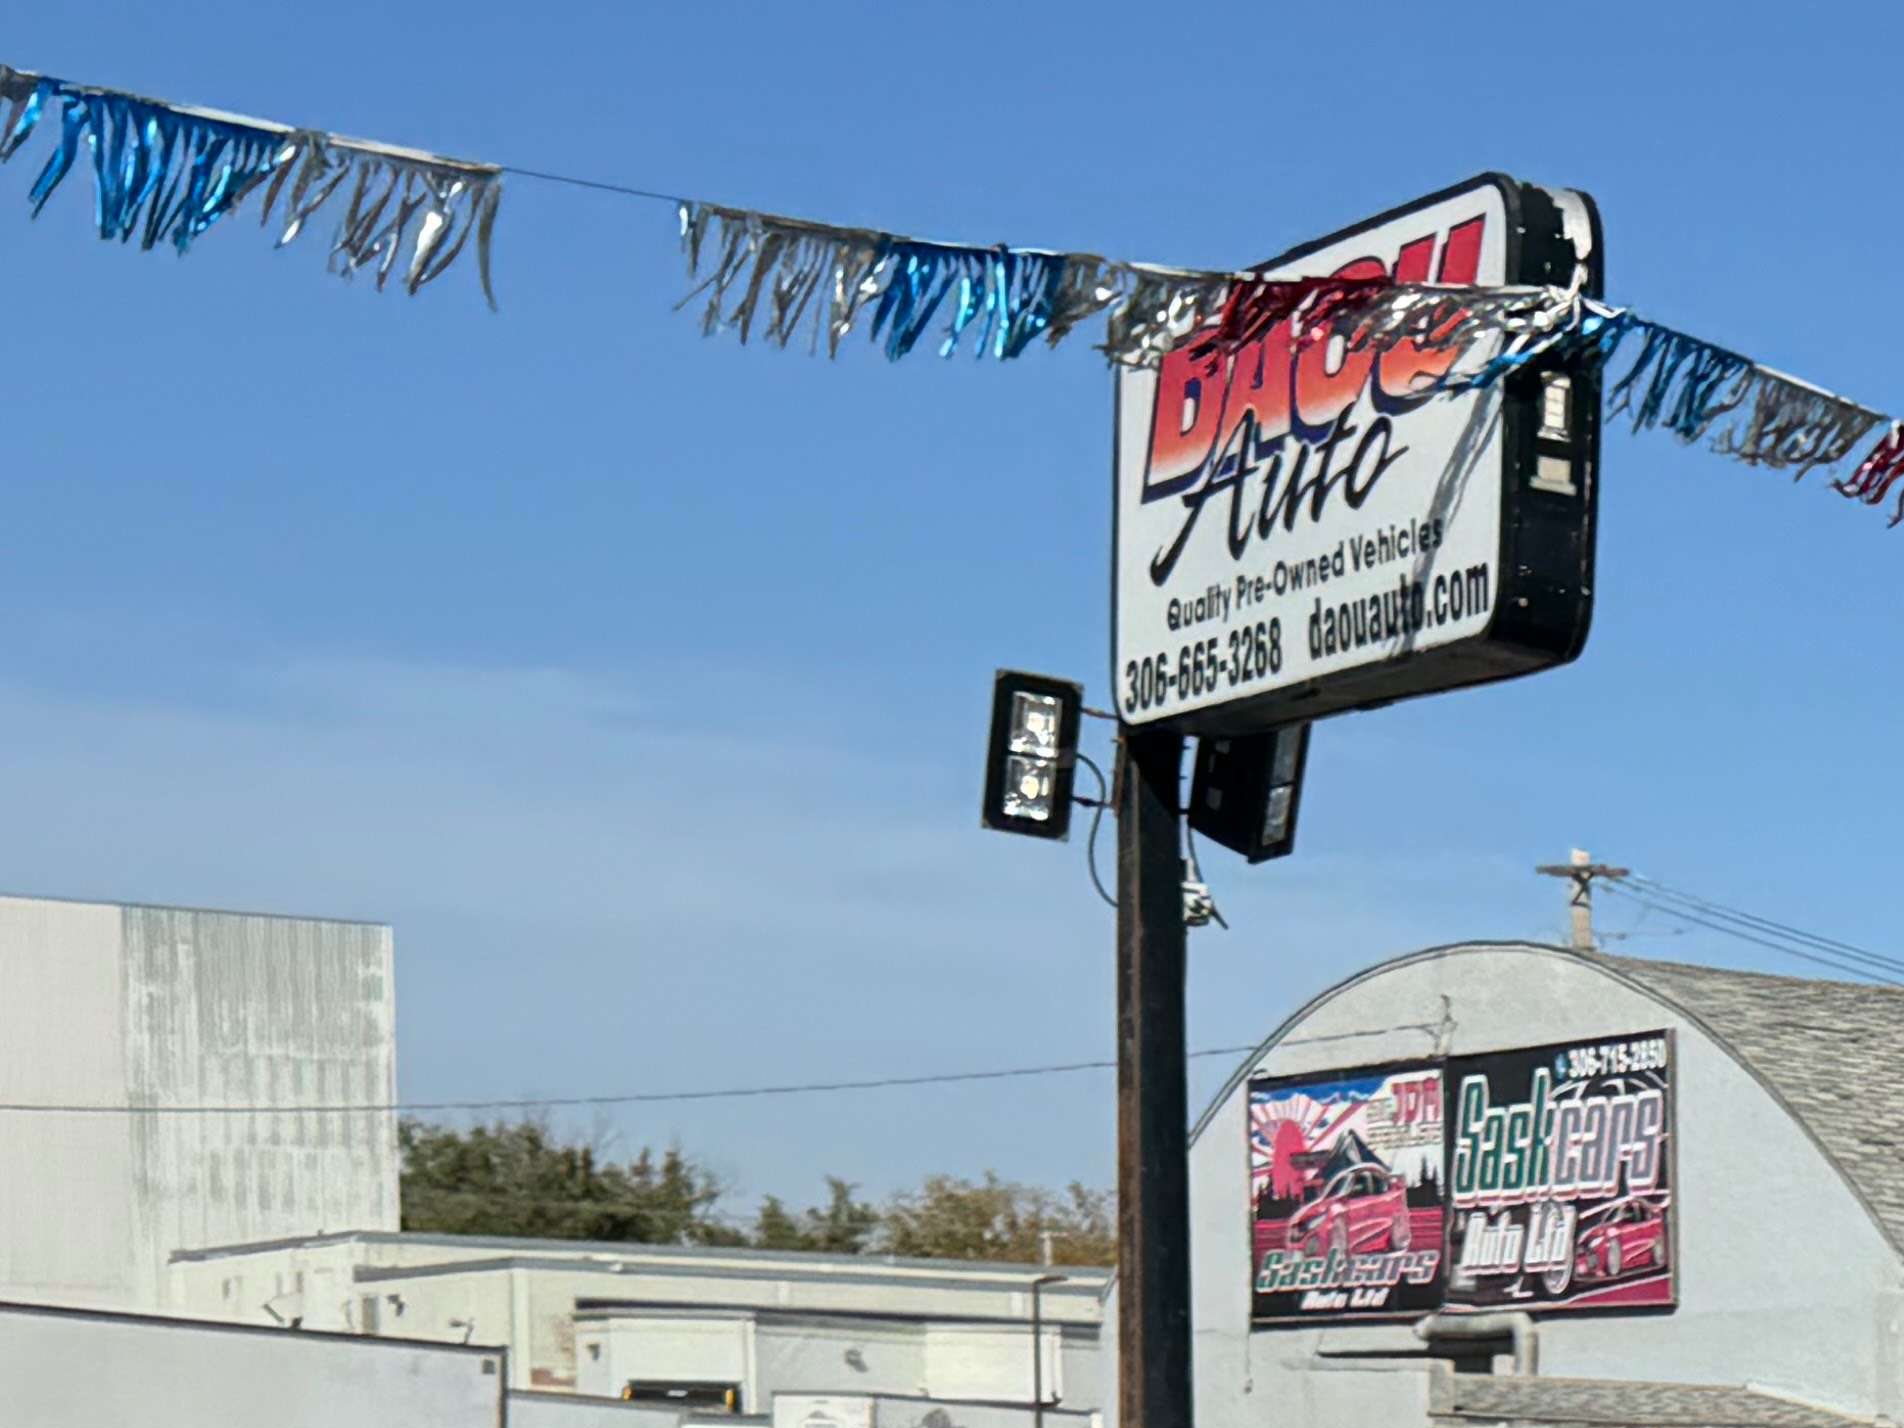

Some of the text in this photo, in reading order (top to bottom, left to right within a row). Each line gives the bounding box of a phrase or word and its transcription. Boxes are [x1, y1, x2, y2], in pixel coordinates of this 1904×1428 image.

[1150, 401, 1410, 588] Auto
[1125, 561, 1490, 713] 306-665-3268 daouauto.com
[1167, 518, 1443, 631] Quality Pre-Owned Vehicles
[1453, 1067, 1663, 1207] Saskcars
